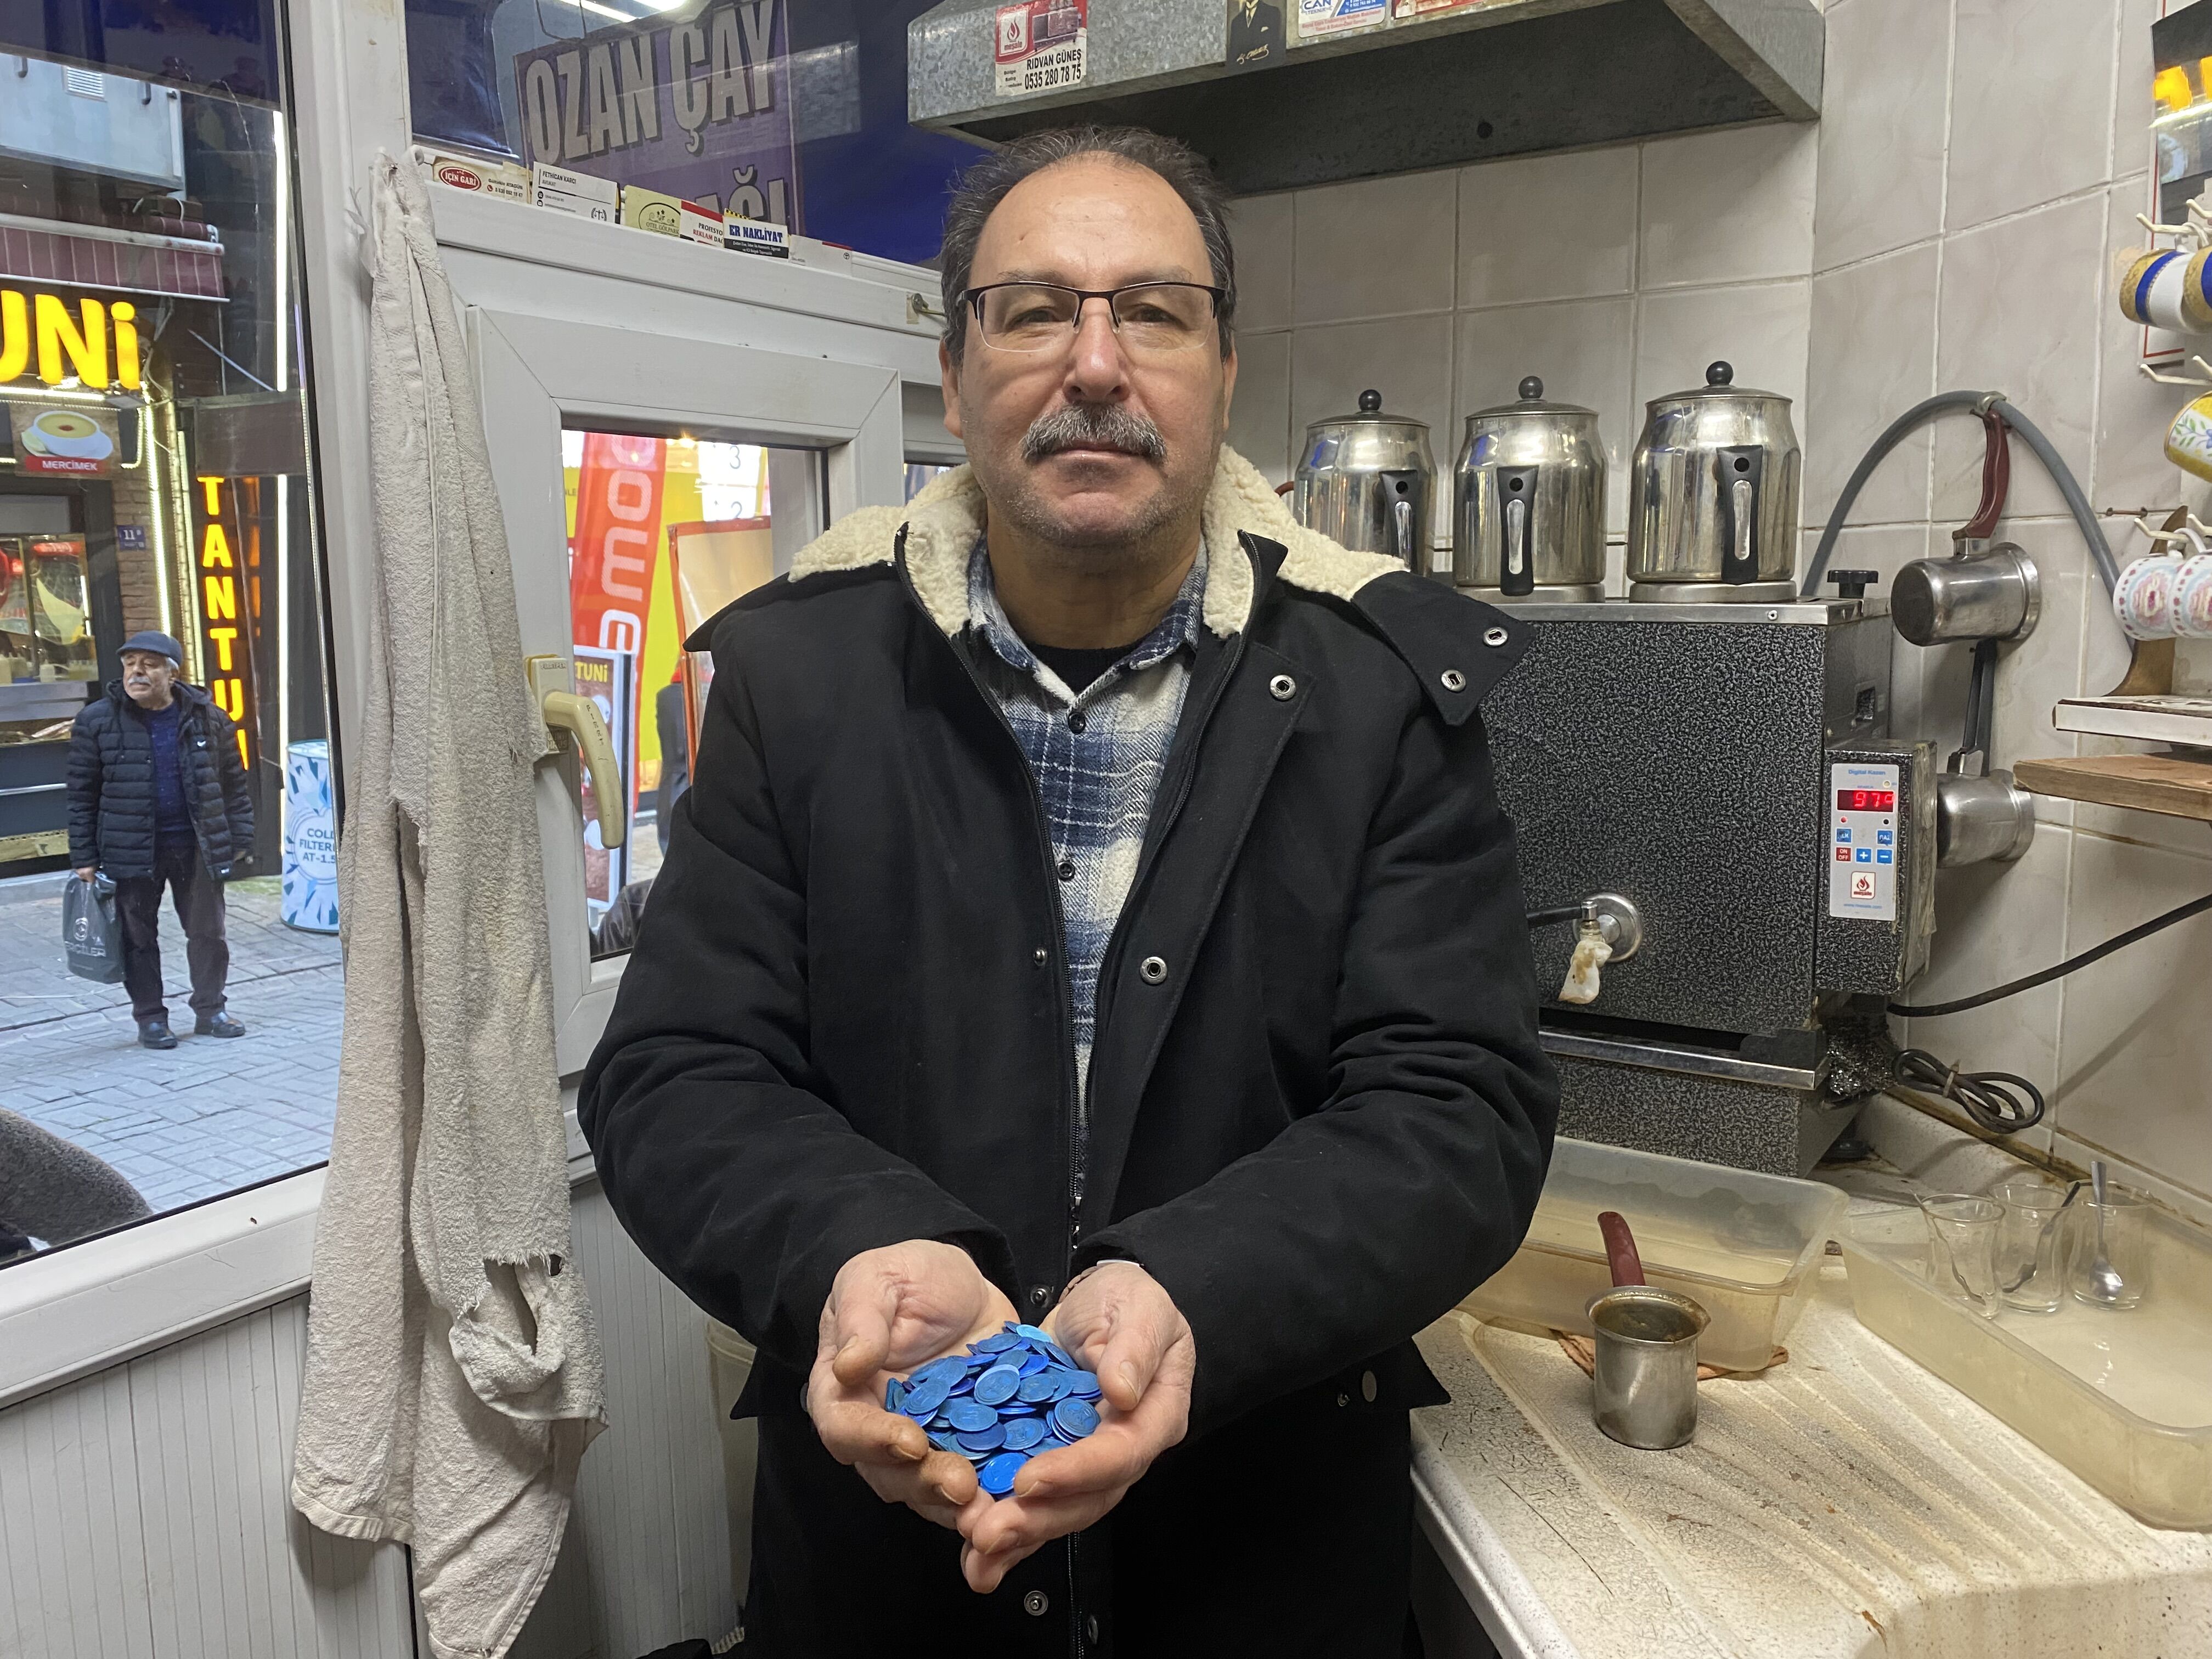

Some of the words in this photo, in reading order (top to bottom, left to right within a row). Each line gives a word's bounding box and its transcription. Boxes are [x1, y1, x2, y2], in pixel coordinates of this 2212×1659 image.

[1027, 54, 1053, 70] RIDVAN
[1056, 49, 1081, 64] GÜNEŞ
[525, 35, 658, 166] OZAN
[669, 1, 775, 155] ÇAY
[1025, 71, 1042, 89] 0535
[1045, 68, 1058, 86] 280
[1060, 66, 1069, 82] 78
[1072, 63, 1081, 80] 75
[693, 229, 713, 240] REKLAM
[698, 223, 723, 236] PROFESYO
[729, 224, 741, 237] ER
[743, 227, 783, 243] NAKLİYAT
[42, 460, 98, 471] MERCİMEK
[300, 838, 335, 851] FILTER
